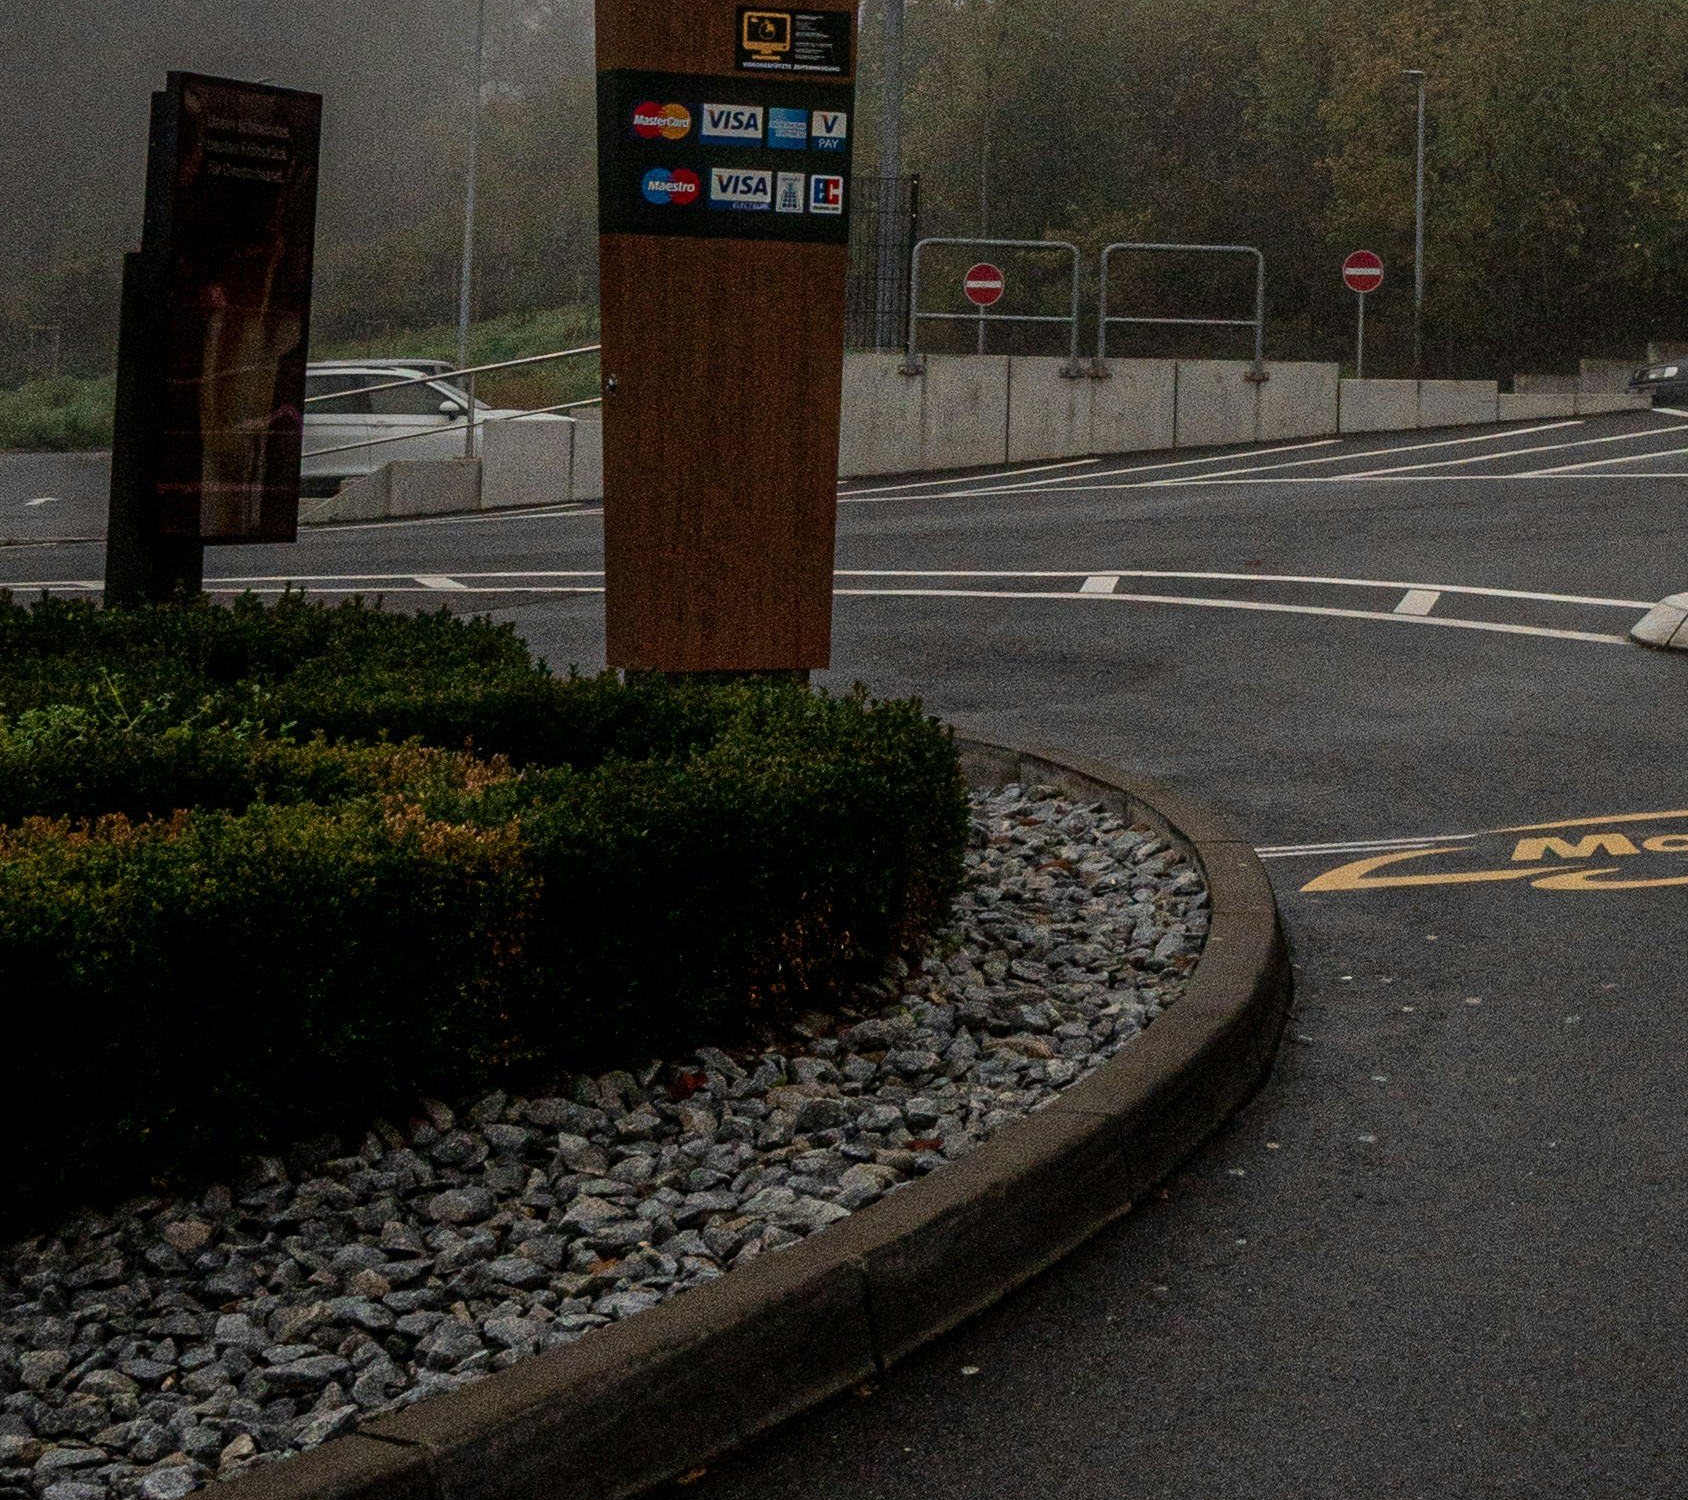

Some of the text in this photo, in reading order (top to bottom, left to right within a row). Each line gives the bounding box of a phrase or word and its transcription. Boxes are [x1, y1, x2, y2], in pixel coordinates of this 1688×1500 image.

[633, 113, 691, 129] MasterCard
[706, 109, 759, 132] VISA
[818, 138, 839, 149] PAY
[647, 178, 696, 194] Maestro
[715, 174, 769, 196] VISA
